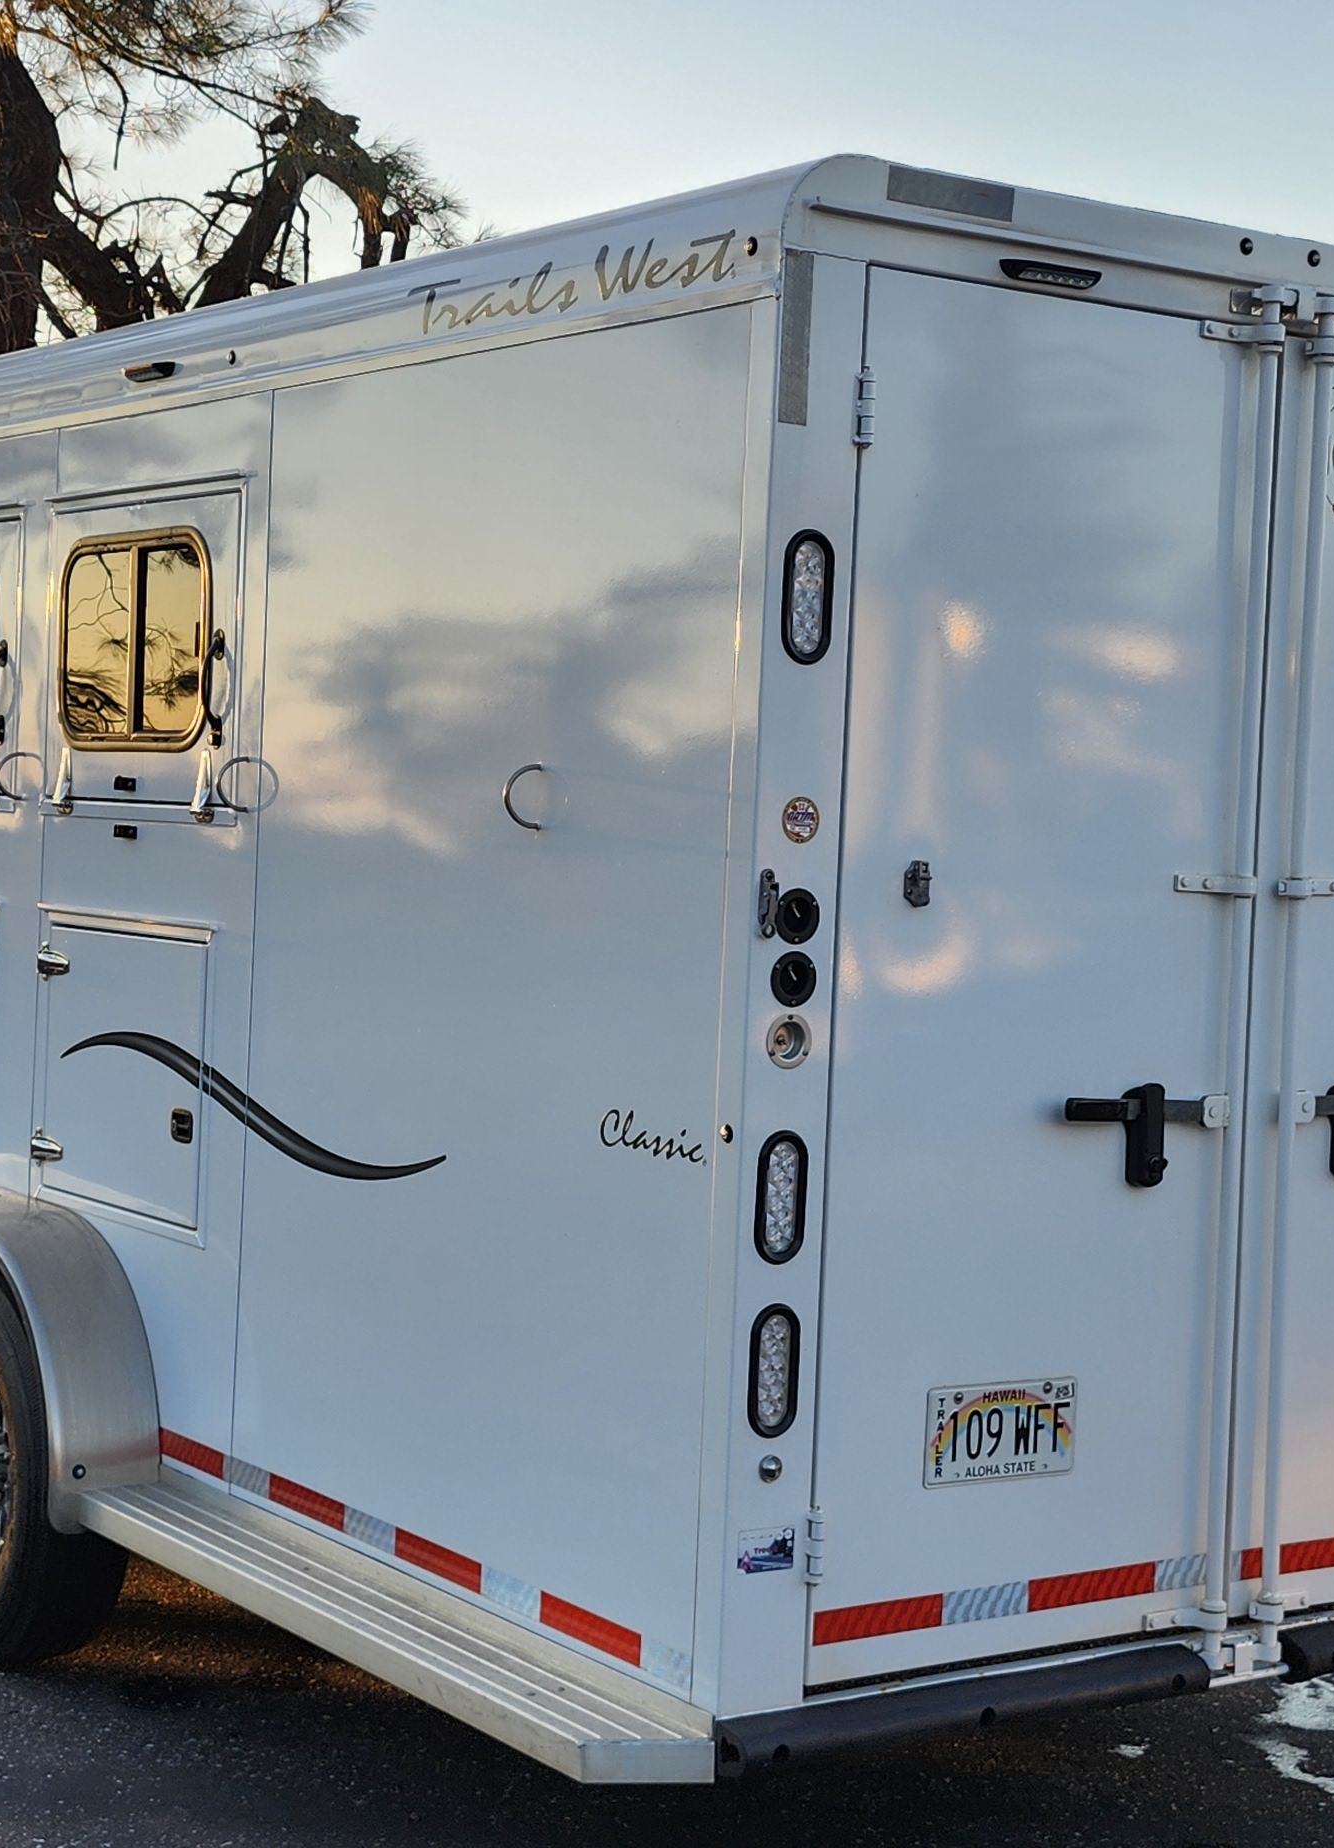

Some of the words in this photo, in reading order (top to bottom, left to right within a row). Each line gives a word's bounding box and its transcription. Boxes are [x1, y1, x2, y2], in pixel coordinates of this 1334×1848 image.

[407, 261, 579, 335] Trails
[594, 228, 736, 300] West
[600, 1109, 704, 1163] Classic
[982, 1389, 1027, 1404] HAWAII
[934, 1398, 946, 1479] TRAILER
[949, 1407, 1004, 1463] 109
[1013, 1401, 1071, 1456] WFF
[964, 1465, 1001, 1478] ALOHA
[1003, 1461, 1036, 1475] STATE
